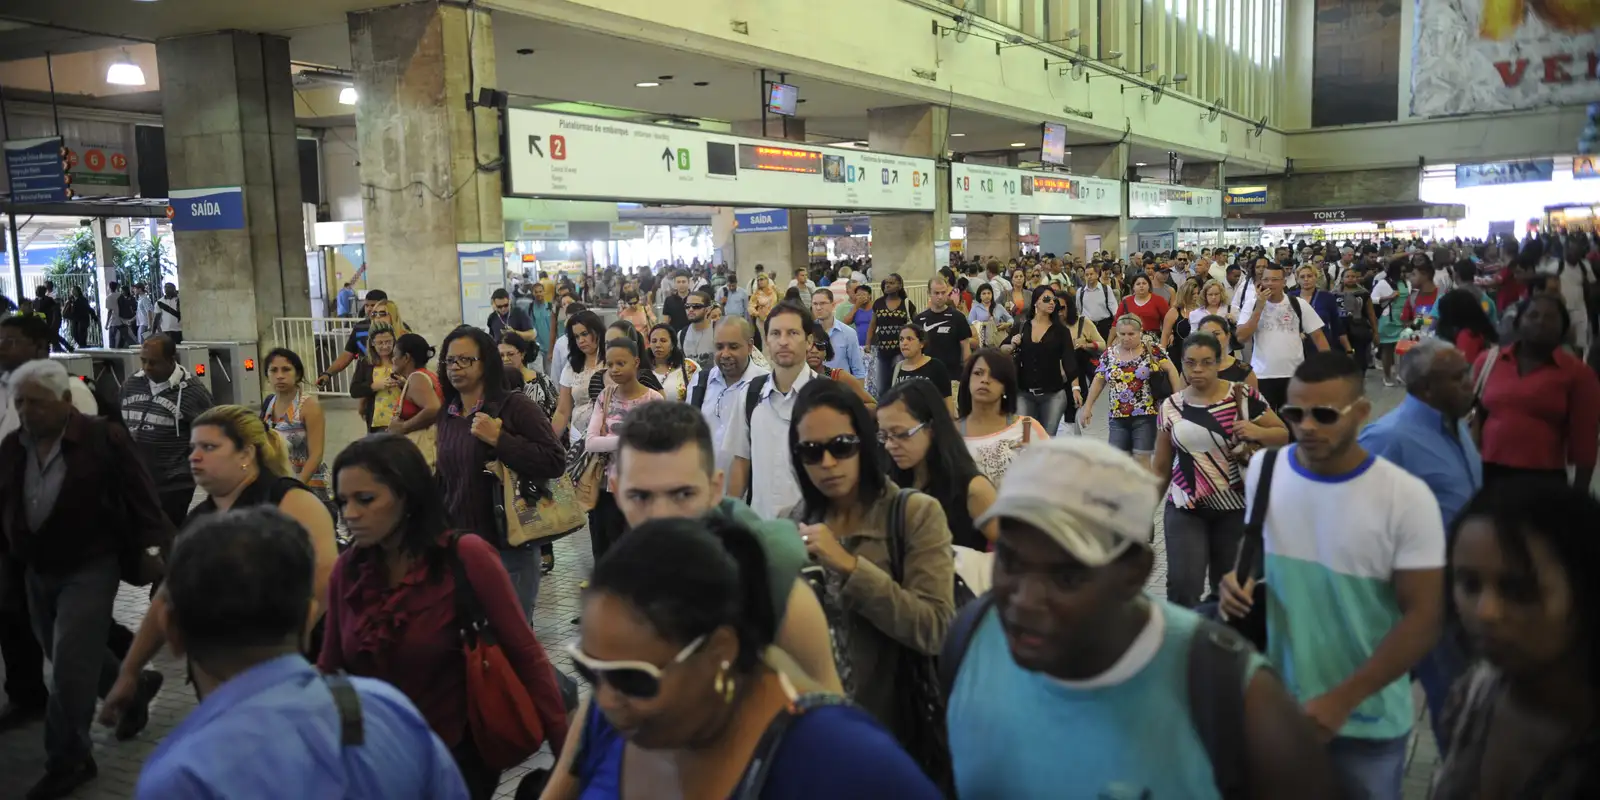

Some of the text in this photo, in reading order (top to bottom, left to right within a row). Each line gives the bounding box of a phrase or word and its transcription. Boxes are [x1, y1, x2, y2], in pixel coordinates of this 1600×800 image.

[559, 119, 593, 132] Plataformas
[594, 124, 601, 133] de
[553, 139, 562, 156] 2
[680, 152, 688, 167] 6
[1233, 196, 1265, 204] Bilheterias
[190, 200, 221, 217] SAÍDA
[750, 213, 773, 225] SAÍDA
